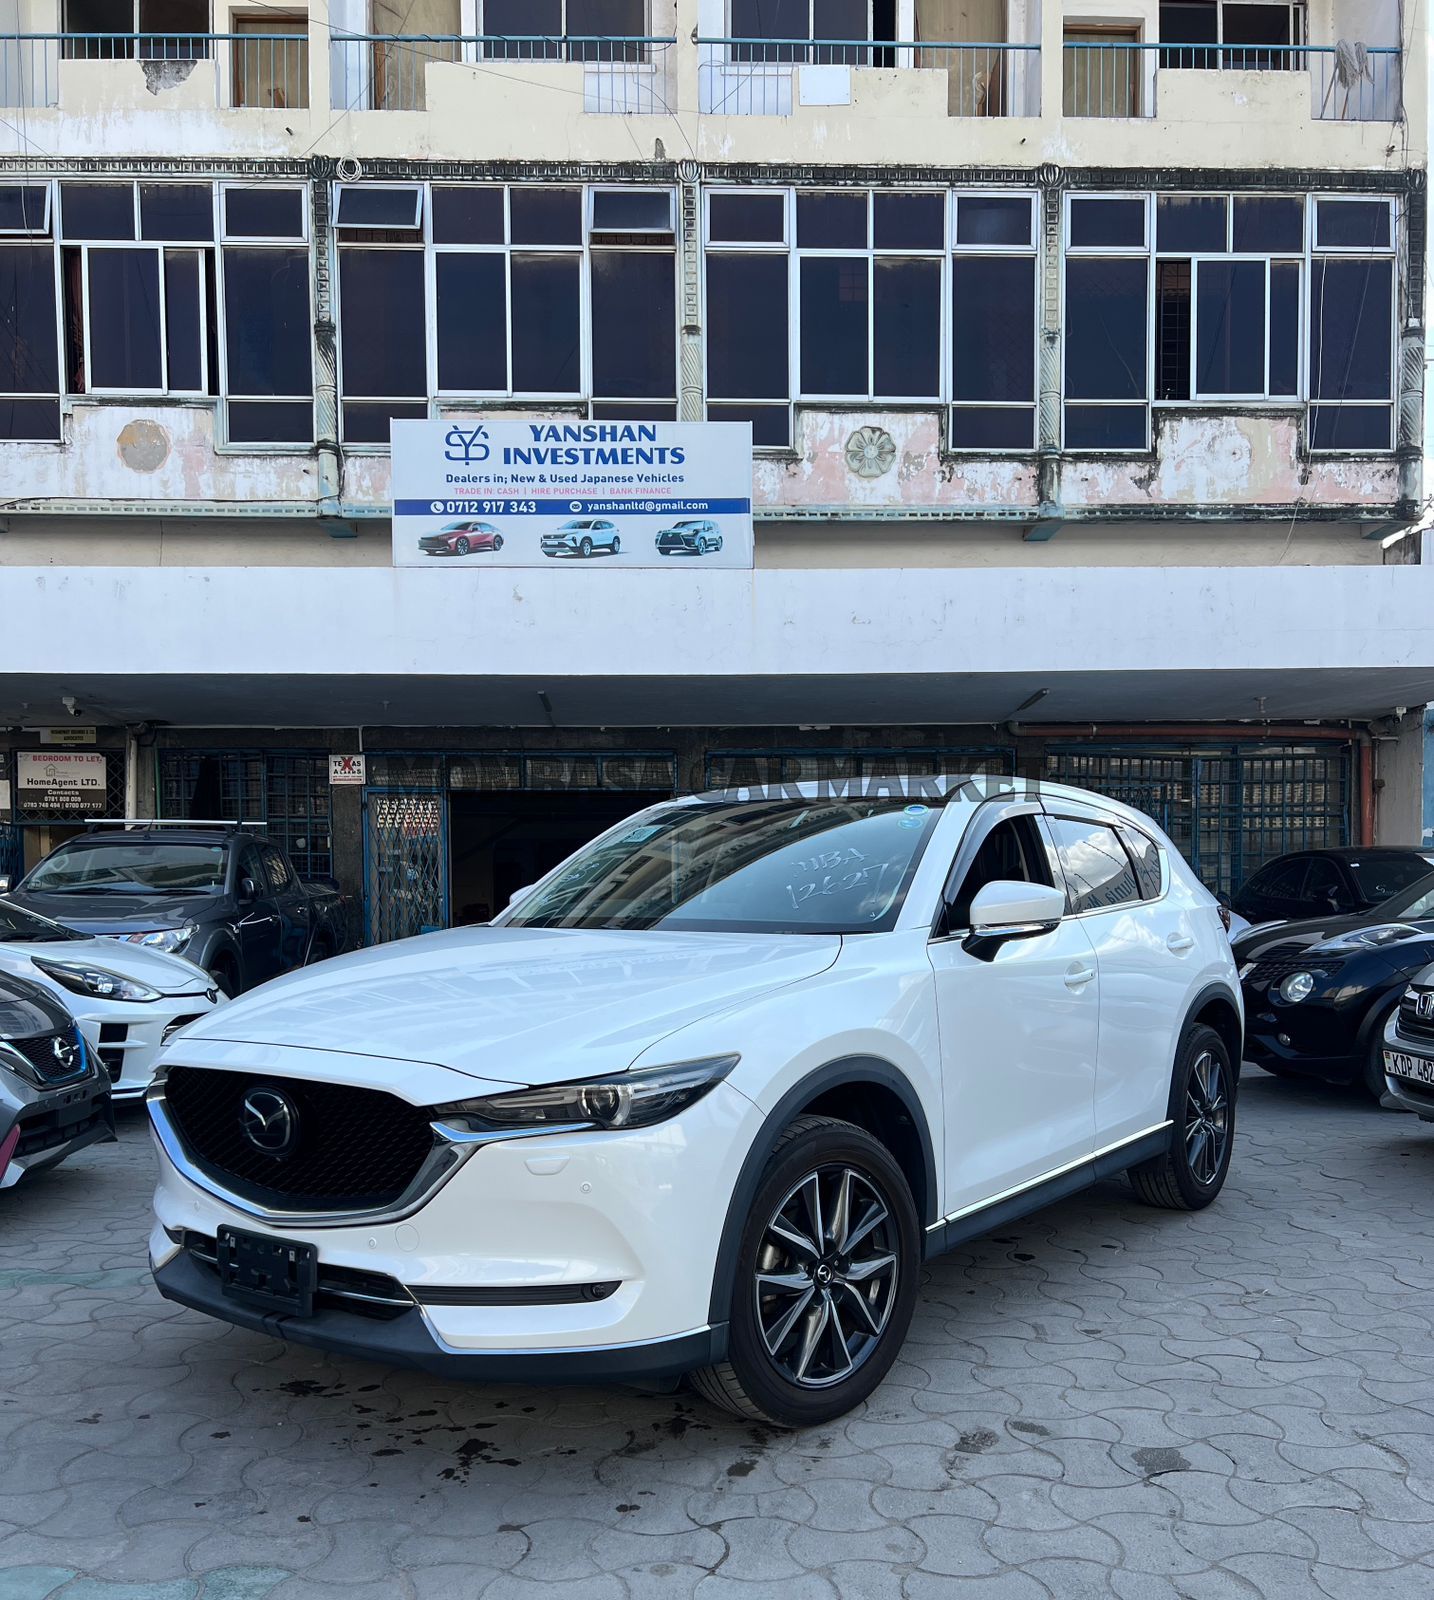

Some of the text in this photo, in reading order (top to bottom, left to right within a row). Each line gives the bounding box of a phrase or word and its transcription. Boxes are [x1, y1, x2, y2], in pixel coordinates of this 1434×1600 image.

[529, 425, 657, 442] YANSHAN
[503, 447, 686, 465] INVESTMENTS
[446, 474, 490, 483] Dealers
[511, 474, 535, 483] New
[539, 474, 547, 483] &
[550, 474, 578, 483] Used
[581, 474, 634, 485] Japanese
[637, 473, 684, 483] Vehicles
[454, 487, 481, 495] TRADE
[497, 487, 520, 495] CASH
[531, 487, 551, 495] HIRE
[553, 487, 598, 495] PURCHASE
[610, 487, 633, 495] BANK
[635, 487, 672, 495] FINANCE
[446, 501, 536, 513] 0712 917 343
[587, 501, 708, 512] yanshanltd@gmail.com
[333, 756, 361, 771] TEXAS
[27, 778, 78, 787] HomeAgent
[1392, 1053, 1412, 1077] KDP
